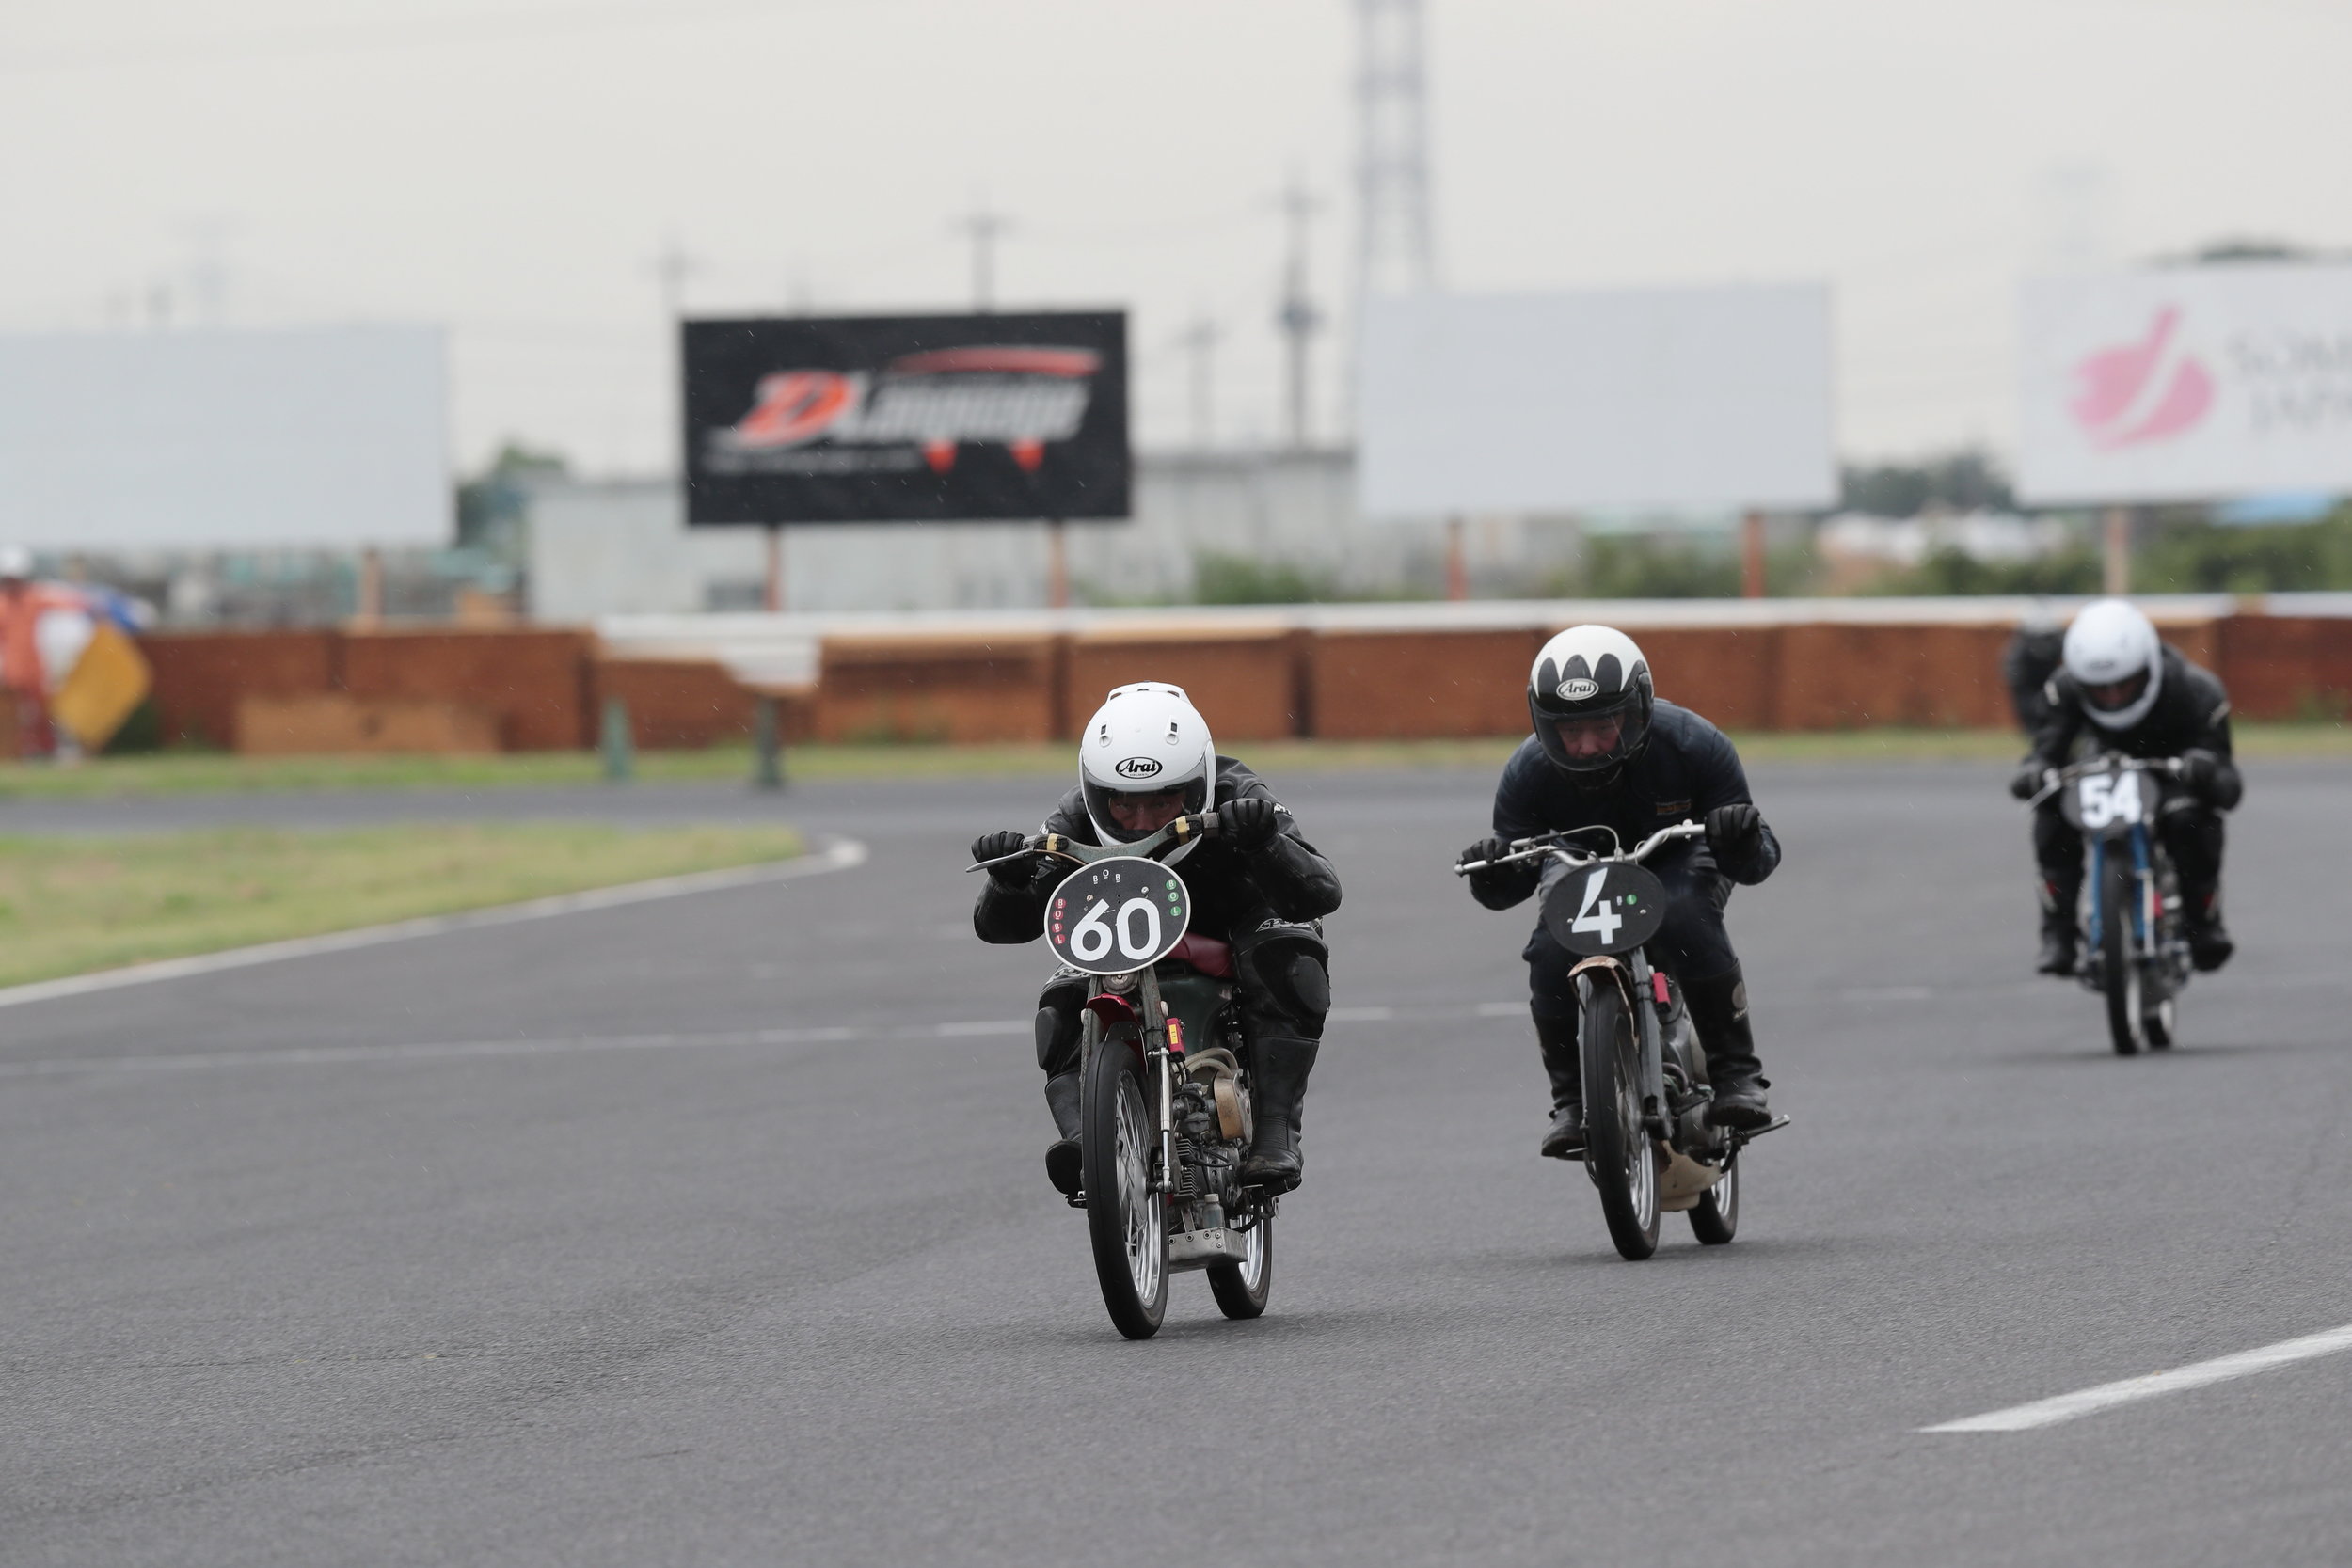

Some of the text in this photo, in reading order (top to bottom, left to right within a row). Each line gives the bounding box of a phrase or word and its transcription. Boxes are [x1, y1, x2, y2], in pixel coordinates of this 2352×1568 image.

[1562, 682, 1592, 694] Arai
[1119, 760, 1157, 772] Arai
[2079, 770, 2142, 828] 54
[1070, 897, 1161, 961] 60
[1571, 867, 1622, 944] 4
